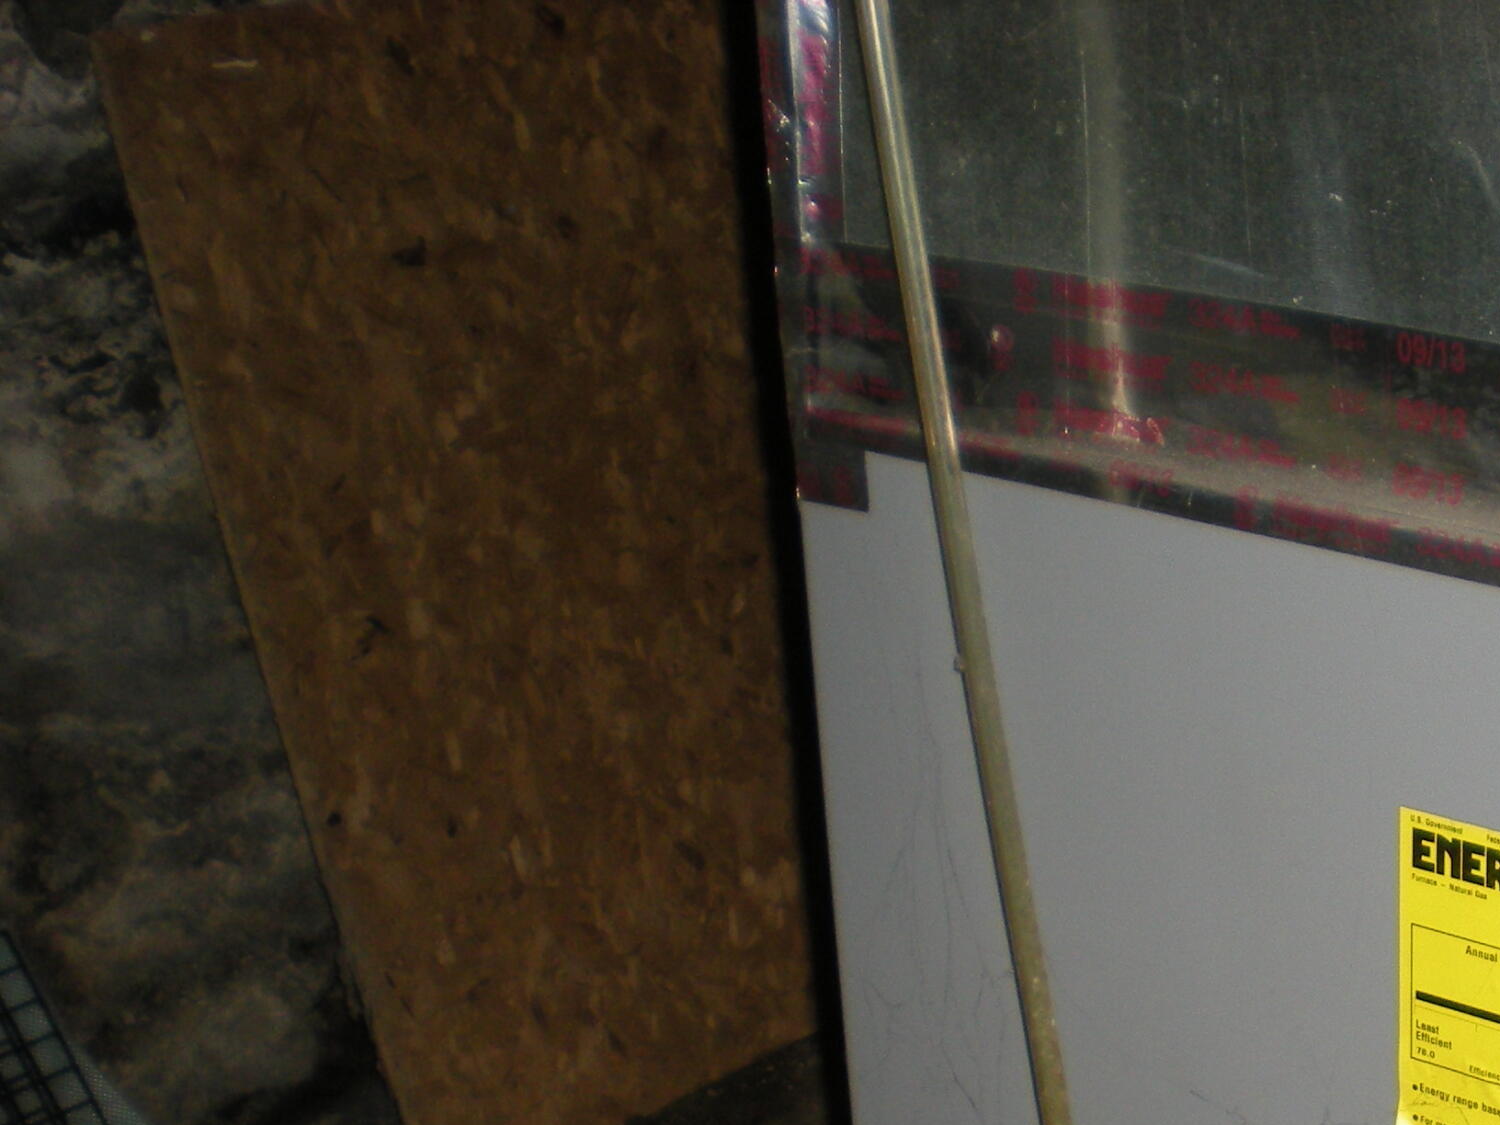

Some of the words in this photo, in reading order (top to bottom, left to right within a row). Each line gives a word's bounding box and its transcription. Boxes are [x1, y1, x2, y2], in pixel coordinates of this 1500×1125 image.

[1395, 331, 1467, 374] 09/13
[1426, 817, 1463, 834] Government
[1449, 883, 1473, 898] Natural
[1474, 890, 1488, 900] Gas
[1465, 945, 1498, 963] Annual
[1416, 1019, 1439, 1034] Least
[1416, 1031, 1453, 1050] Efficient
[1419, 1082, 1450, 1103] Energy
[1453, 1094, 1479, 1110] range
[1420, 1115, 1433, 1125] For
